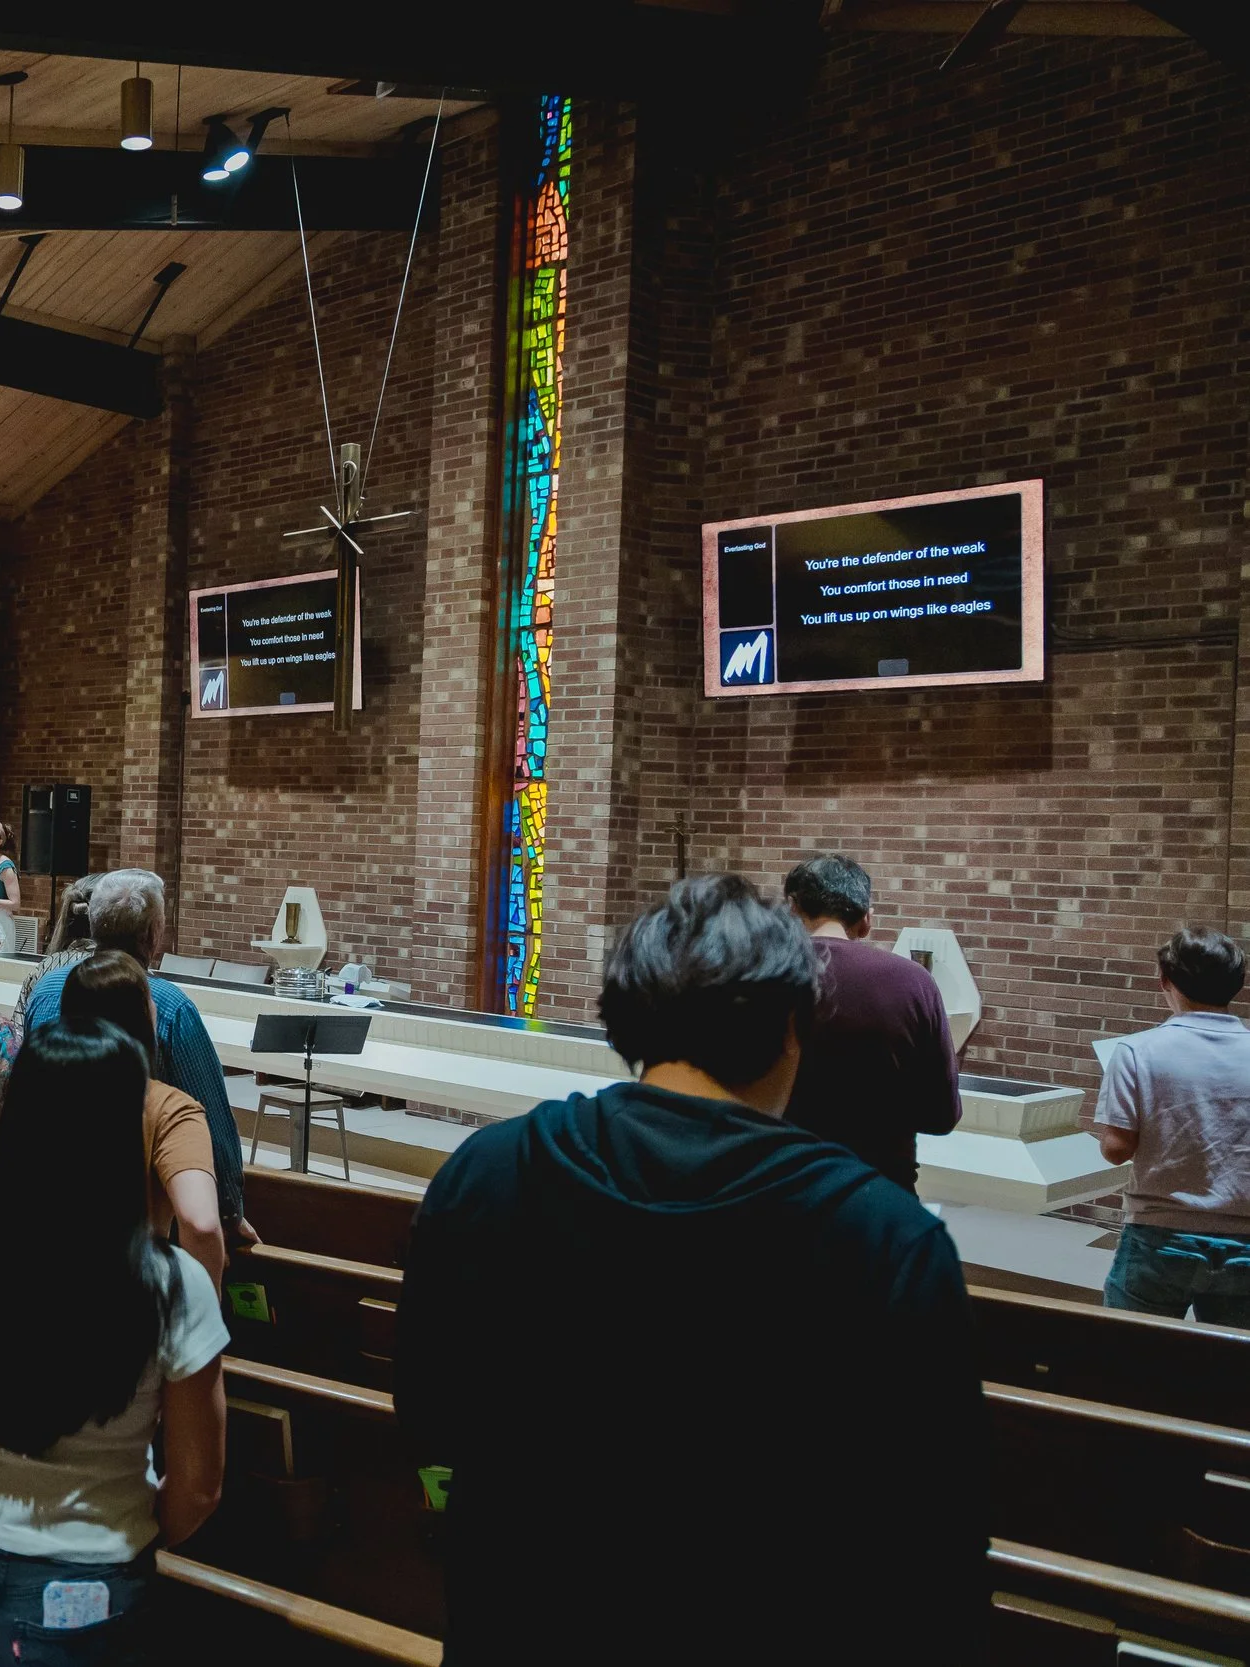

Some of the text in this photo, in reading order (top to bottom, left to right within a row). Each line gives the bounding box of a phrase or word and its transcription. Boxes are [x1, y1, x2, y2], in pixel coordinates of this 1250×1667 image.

[805, 542, 985, 570] You're the defender of the weak
[820, 572, 967, 596] You comfort those in need
[242, 619, 259, 627] You're
[271, 614, 296, 624] defender
[297, 612, 304, 621] of
[305, 612, 314, 620] the
[315, 610, 332, 618] weak
[801, 600, 991, 625] You lift us up on wings like eagles
[250, 638, 261, 646] You
[262, 636, 283, 645] comfort
[302, 633, 307, 641] in
[309, 631, 324, 640] need
[285, 655, 302, 663] wings
[303, 653, 314, 661] like
[315, 651, 335, 661] eagles
